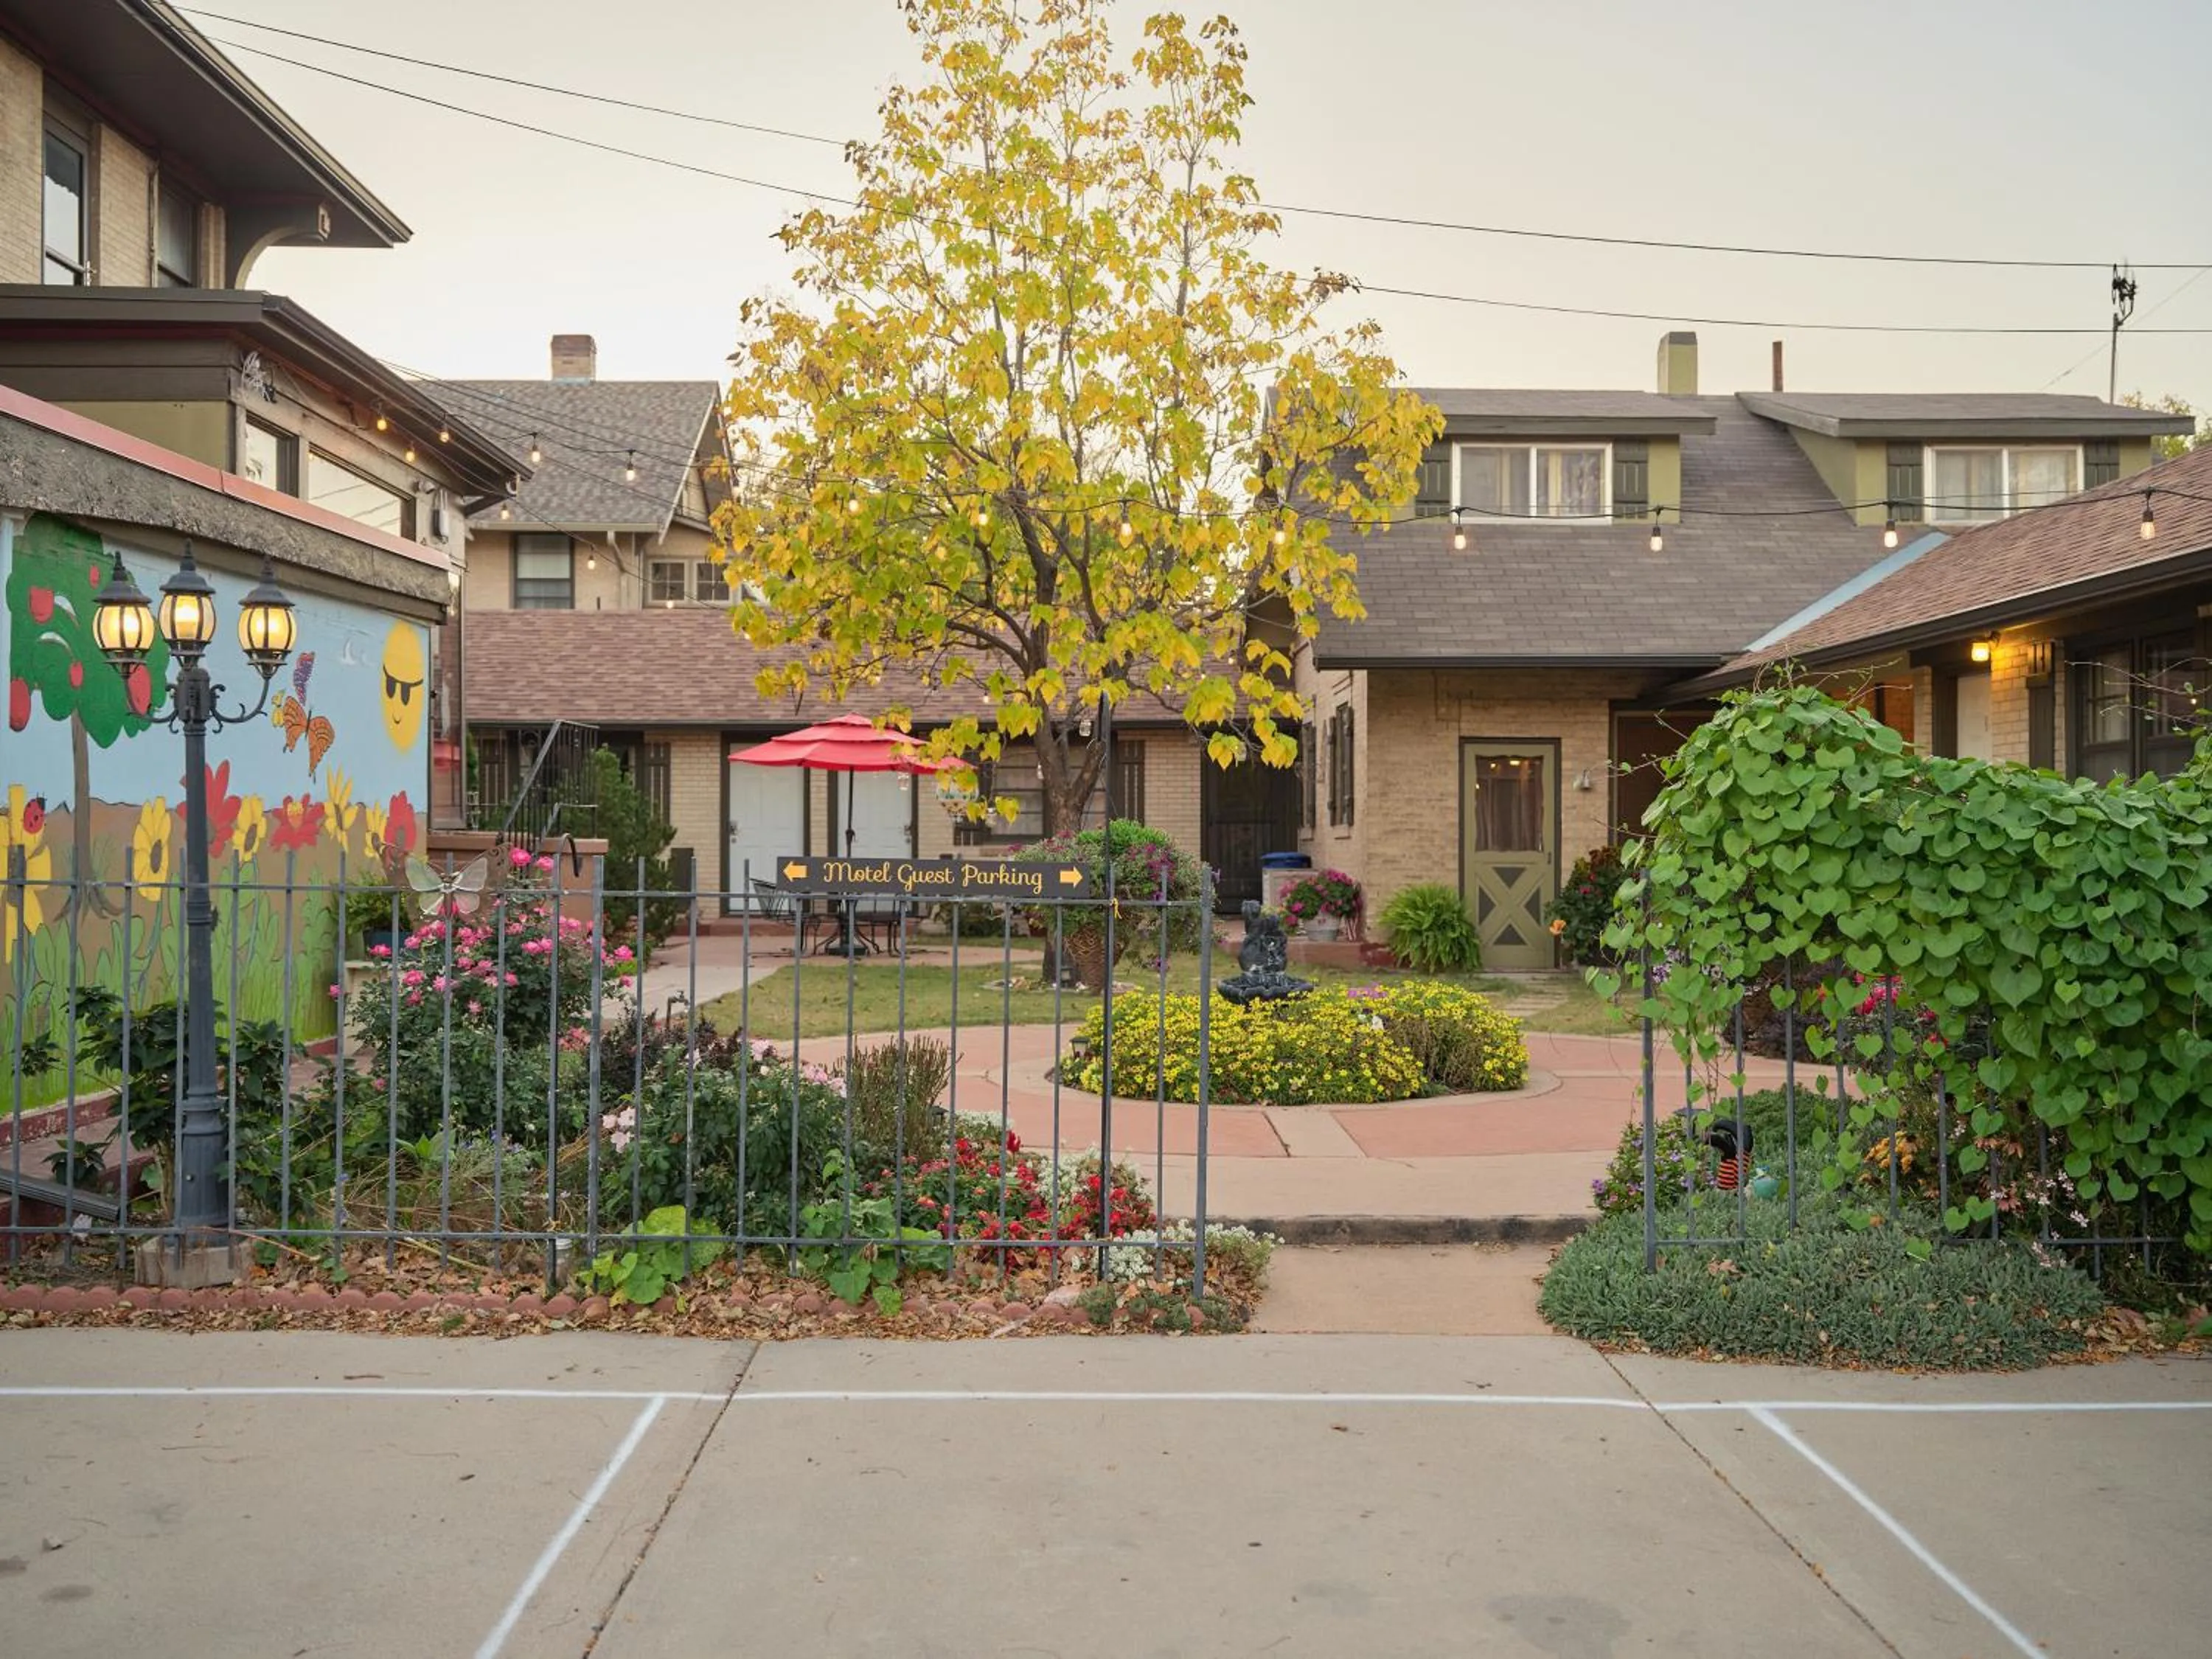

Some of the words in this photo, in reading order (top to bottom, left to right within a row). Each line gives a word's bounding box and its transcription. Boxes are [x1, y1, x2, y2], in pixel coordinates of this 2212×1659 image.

[824, 862, 891, 883] Motel
[897, 863, 954, 891] Guest
[961, 863, 1043, 894] Parking
